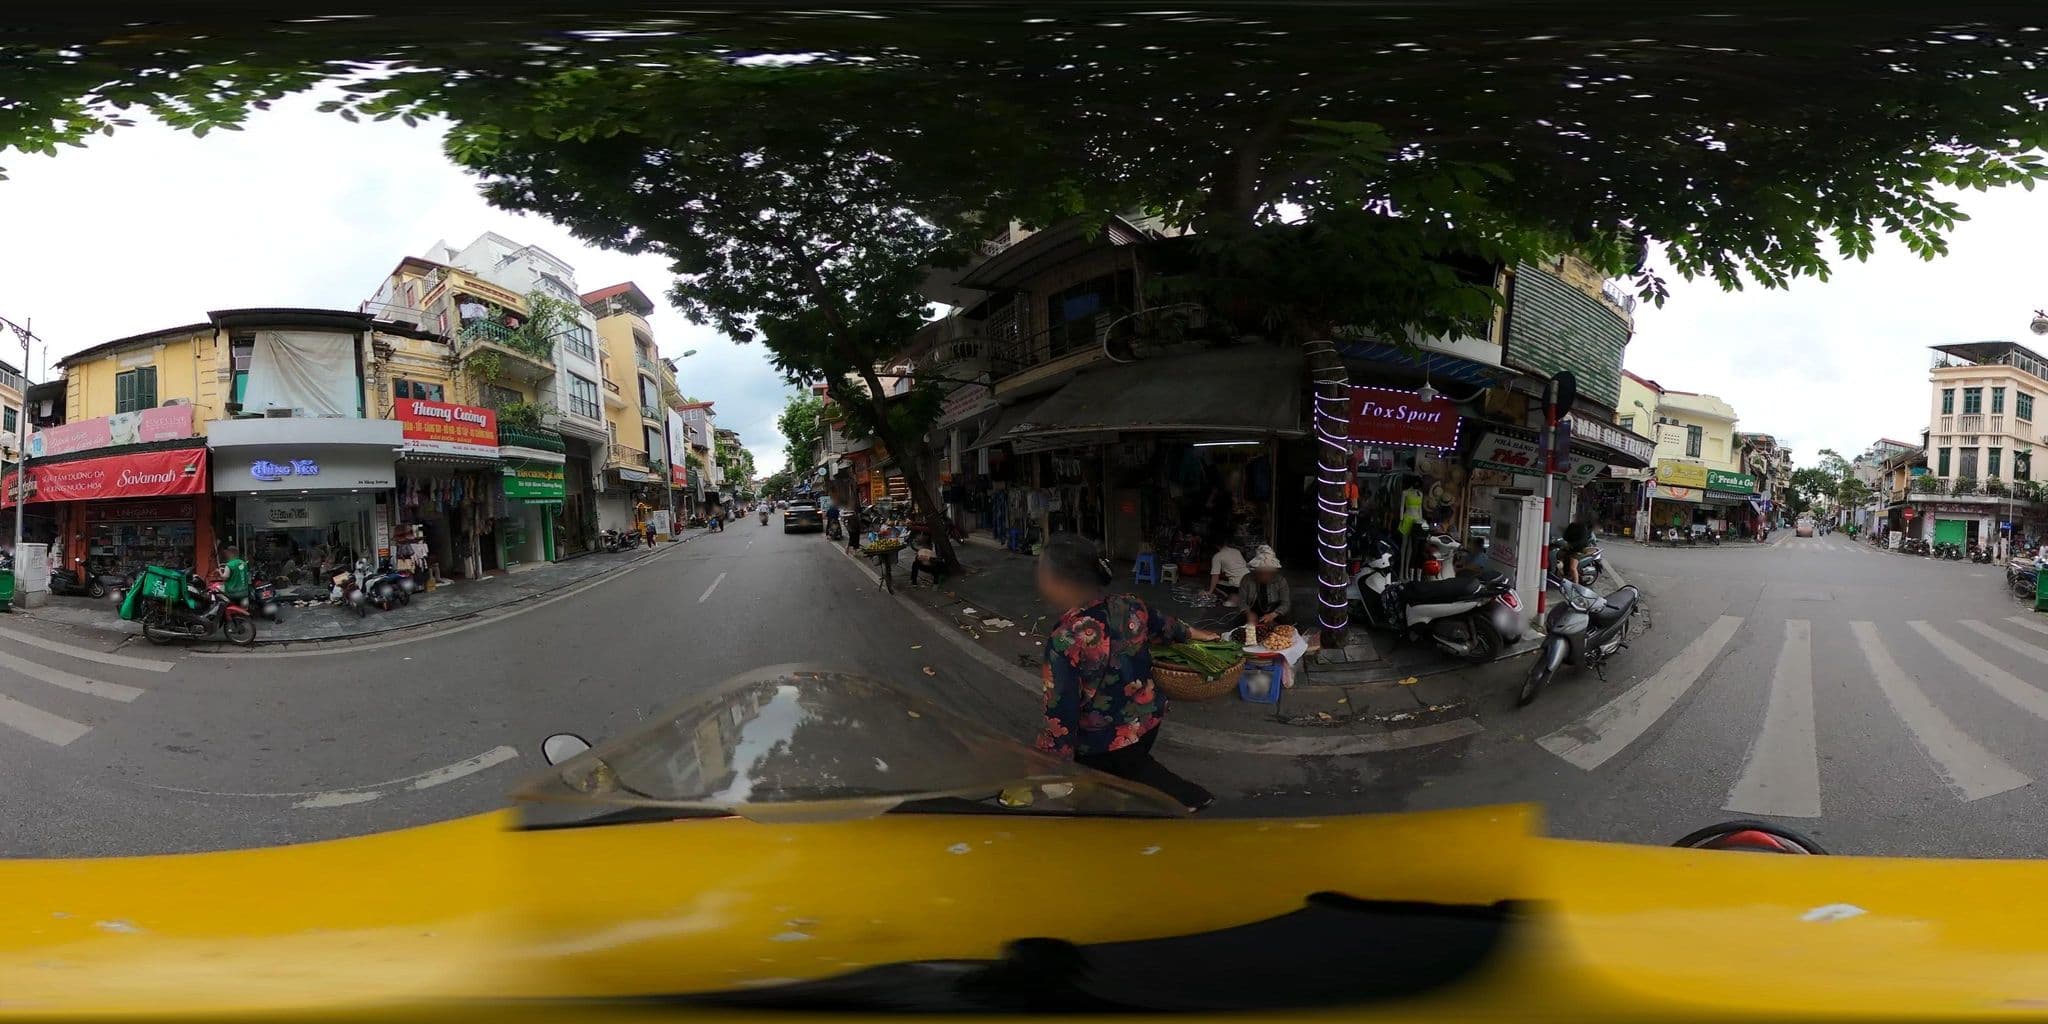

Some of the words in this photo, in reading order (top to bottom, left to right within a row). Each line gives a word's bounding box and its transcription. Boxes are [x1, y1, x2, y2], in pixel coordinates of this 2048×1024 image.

[1577, 418, 1601, 440] MAI
[1603, 428, 1622, 448] GIA
[116, 469, 176, 487] Savannah
[1718, 475, 1738, 485] Fresh
[1744, 479, 1754, 487] Go
